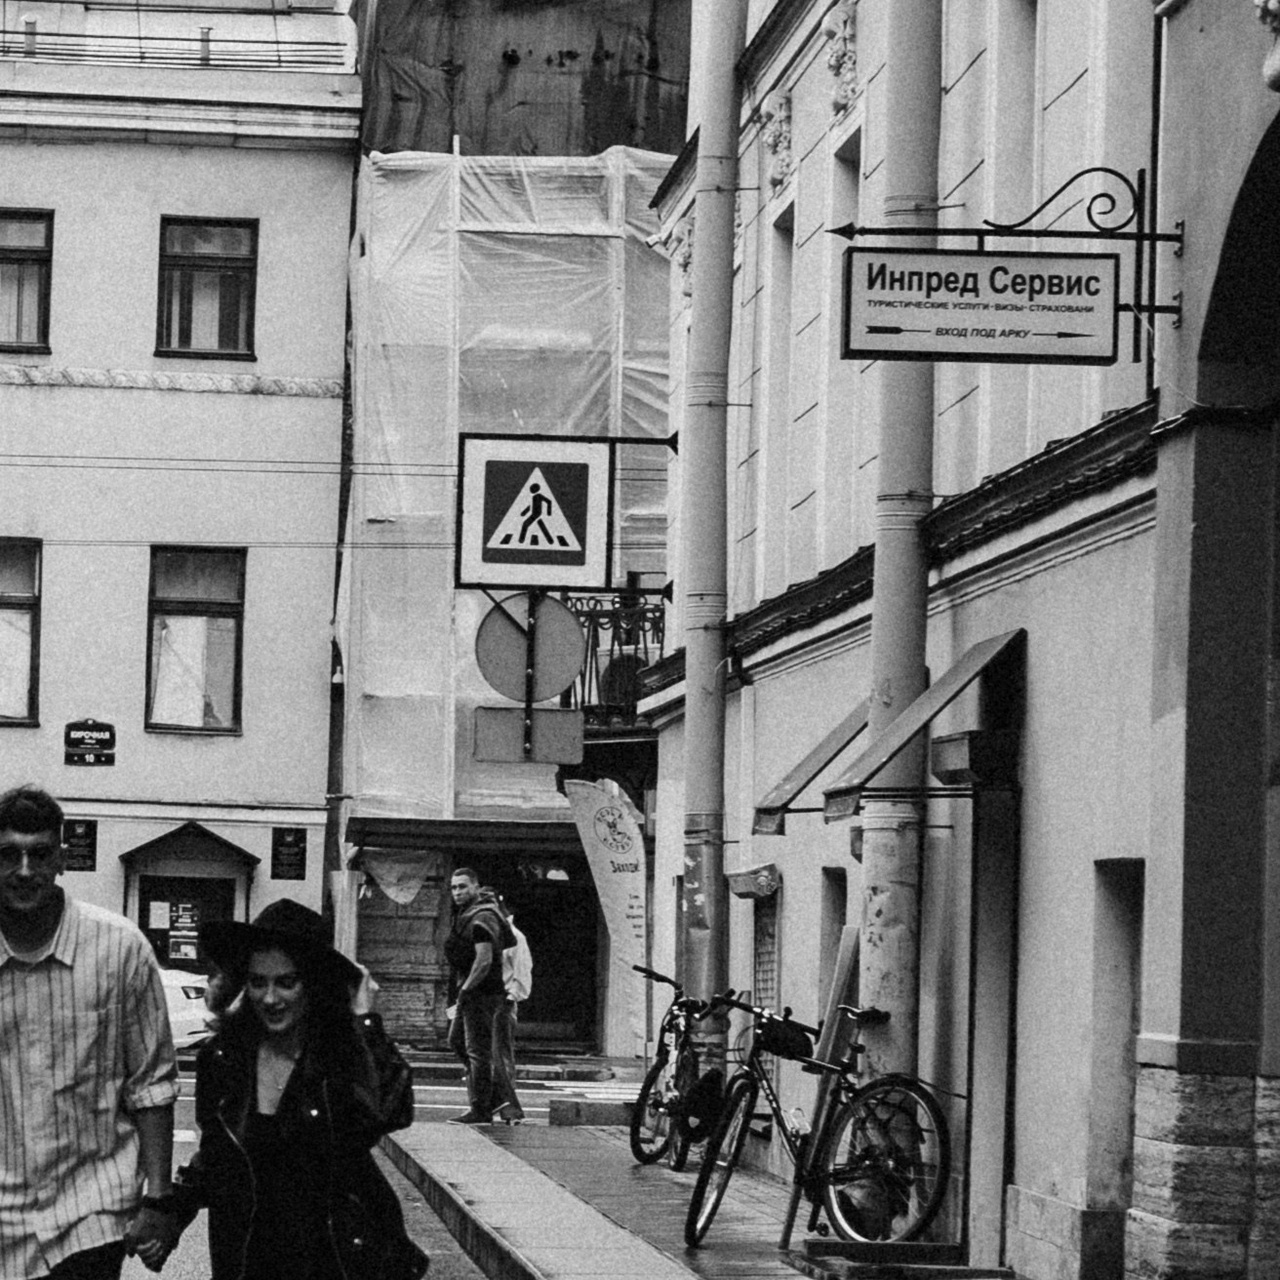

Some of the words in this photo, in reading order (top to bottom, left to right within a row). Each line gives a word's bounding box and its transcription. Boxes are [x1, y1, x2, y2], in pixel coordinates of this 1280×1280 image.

[867, 263, 980, 299] Инпред
[989, 265, 1101, 302] Сервис
[867, 299, 949, 310] ТУРИСТИЧЕСКИЕ
[935, 327, 968, 338] ВХОД
[970, 328, 996, 339] ПОД
[998, 328, 1031, 339] АРКУ
[84, 753, 95, 762] 10
